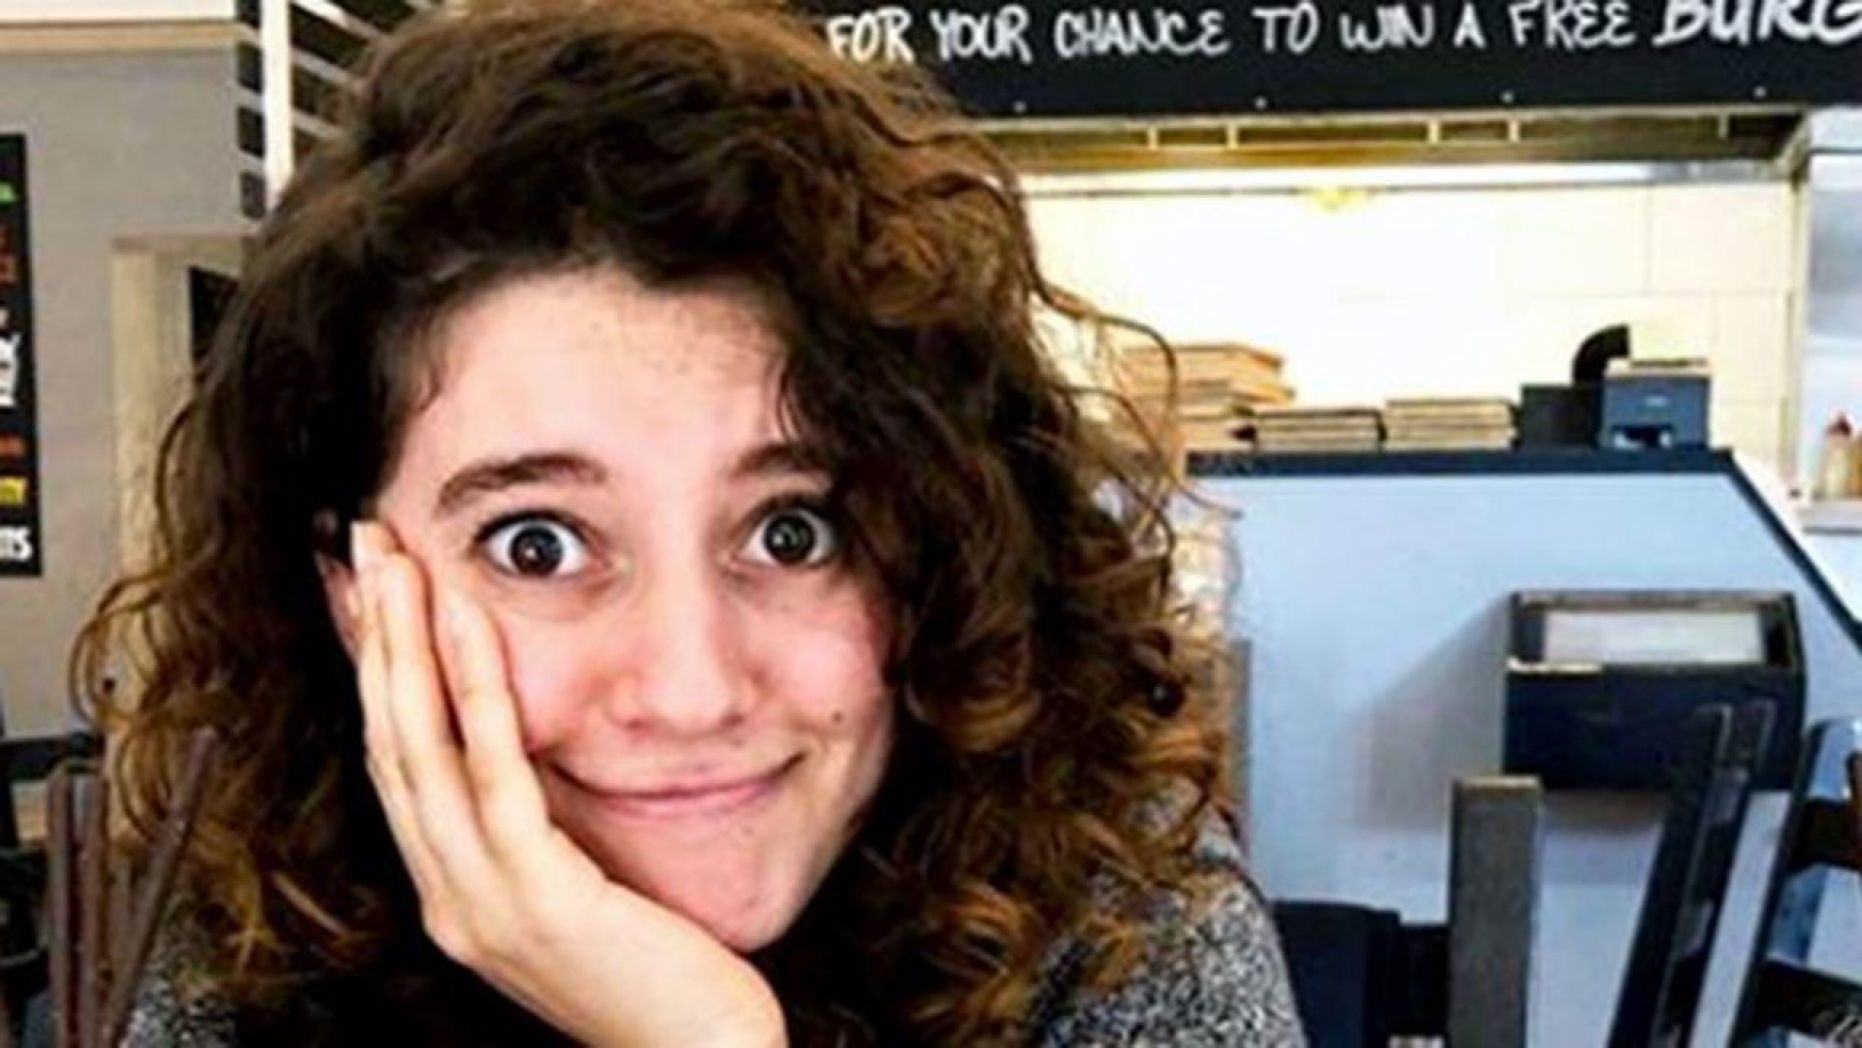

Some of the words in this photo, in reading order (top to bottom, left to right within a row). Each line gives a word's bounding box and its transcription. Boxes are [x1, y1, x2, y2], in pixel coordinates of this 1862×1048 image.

[826, 7, 915, 64] FOR
[930, 4, 1033, 64] YOUR
[1054, 8, 1230, 58] CHANCE
[1252, 1, 1319, 54] TO
[1339, 4, 1434, 49] WIN
[1453, 3, 1486, 48] A
[1508, 0, 1637, 51] FREE
